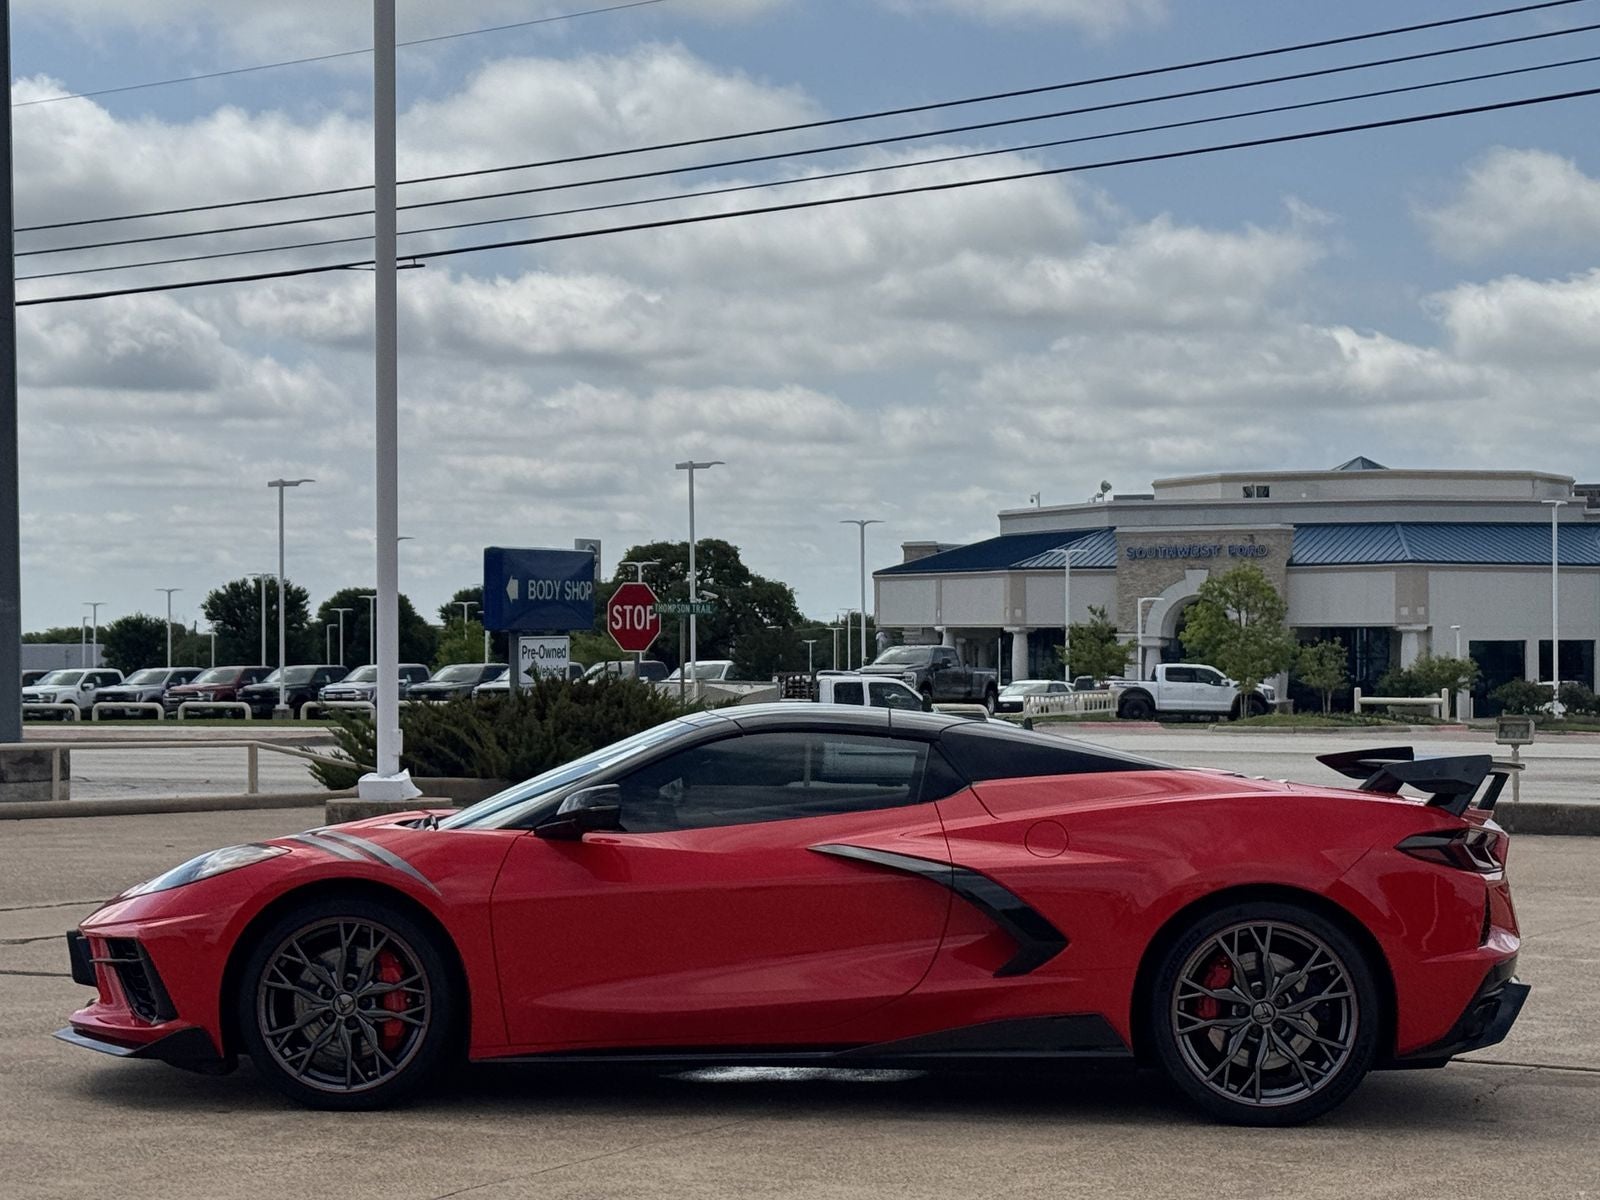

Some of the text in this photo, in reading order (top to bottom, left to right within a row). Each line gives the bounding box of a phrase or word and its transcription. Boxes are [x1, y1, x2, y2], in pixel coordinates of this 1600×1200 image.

[1126, 543, 1269, 560] SOUTHWEST FORD
[528, 579, 593, 601] BODY SHOP
[654, 602, 713, 614] THOMPSON TRAIL
[611, 604, 657, 630] STOP
[521, 644, 567, 660] Pre-Owned
